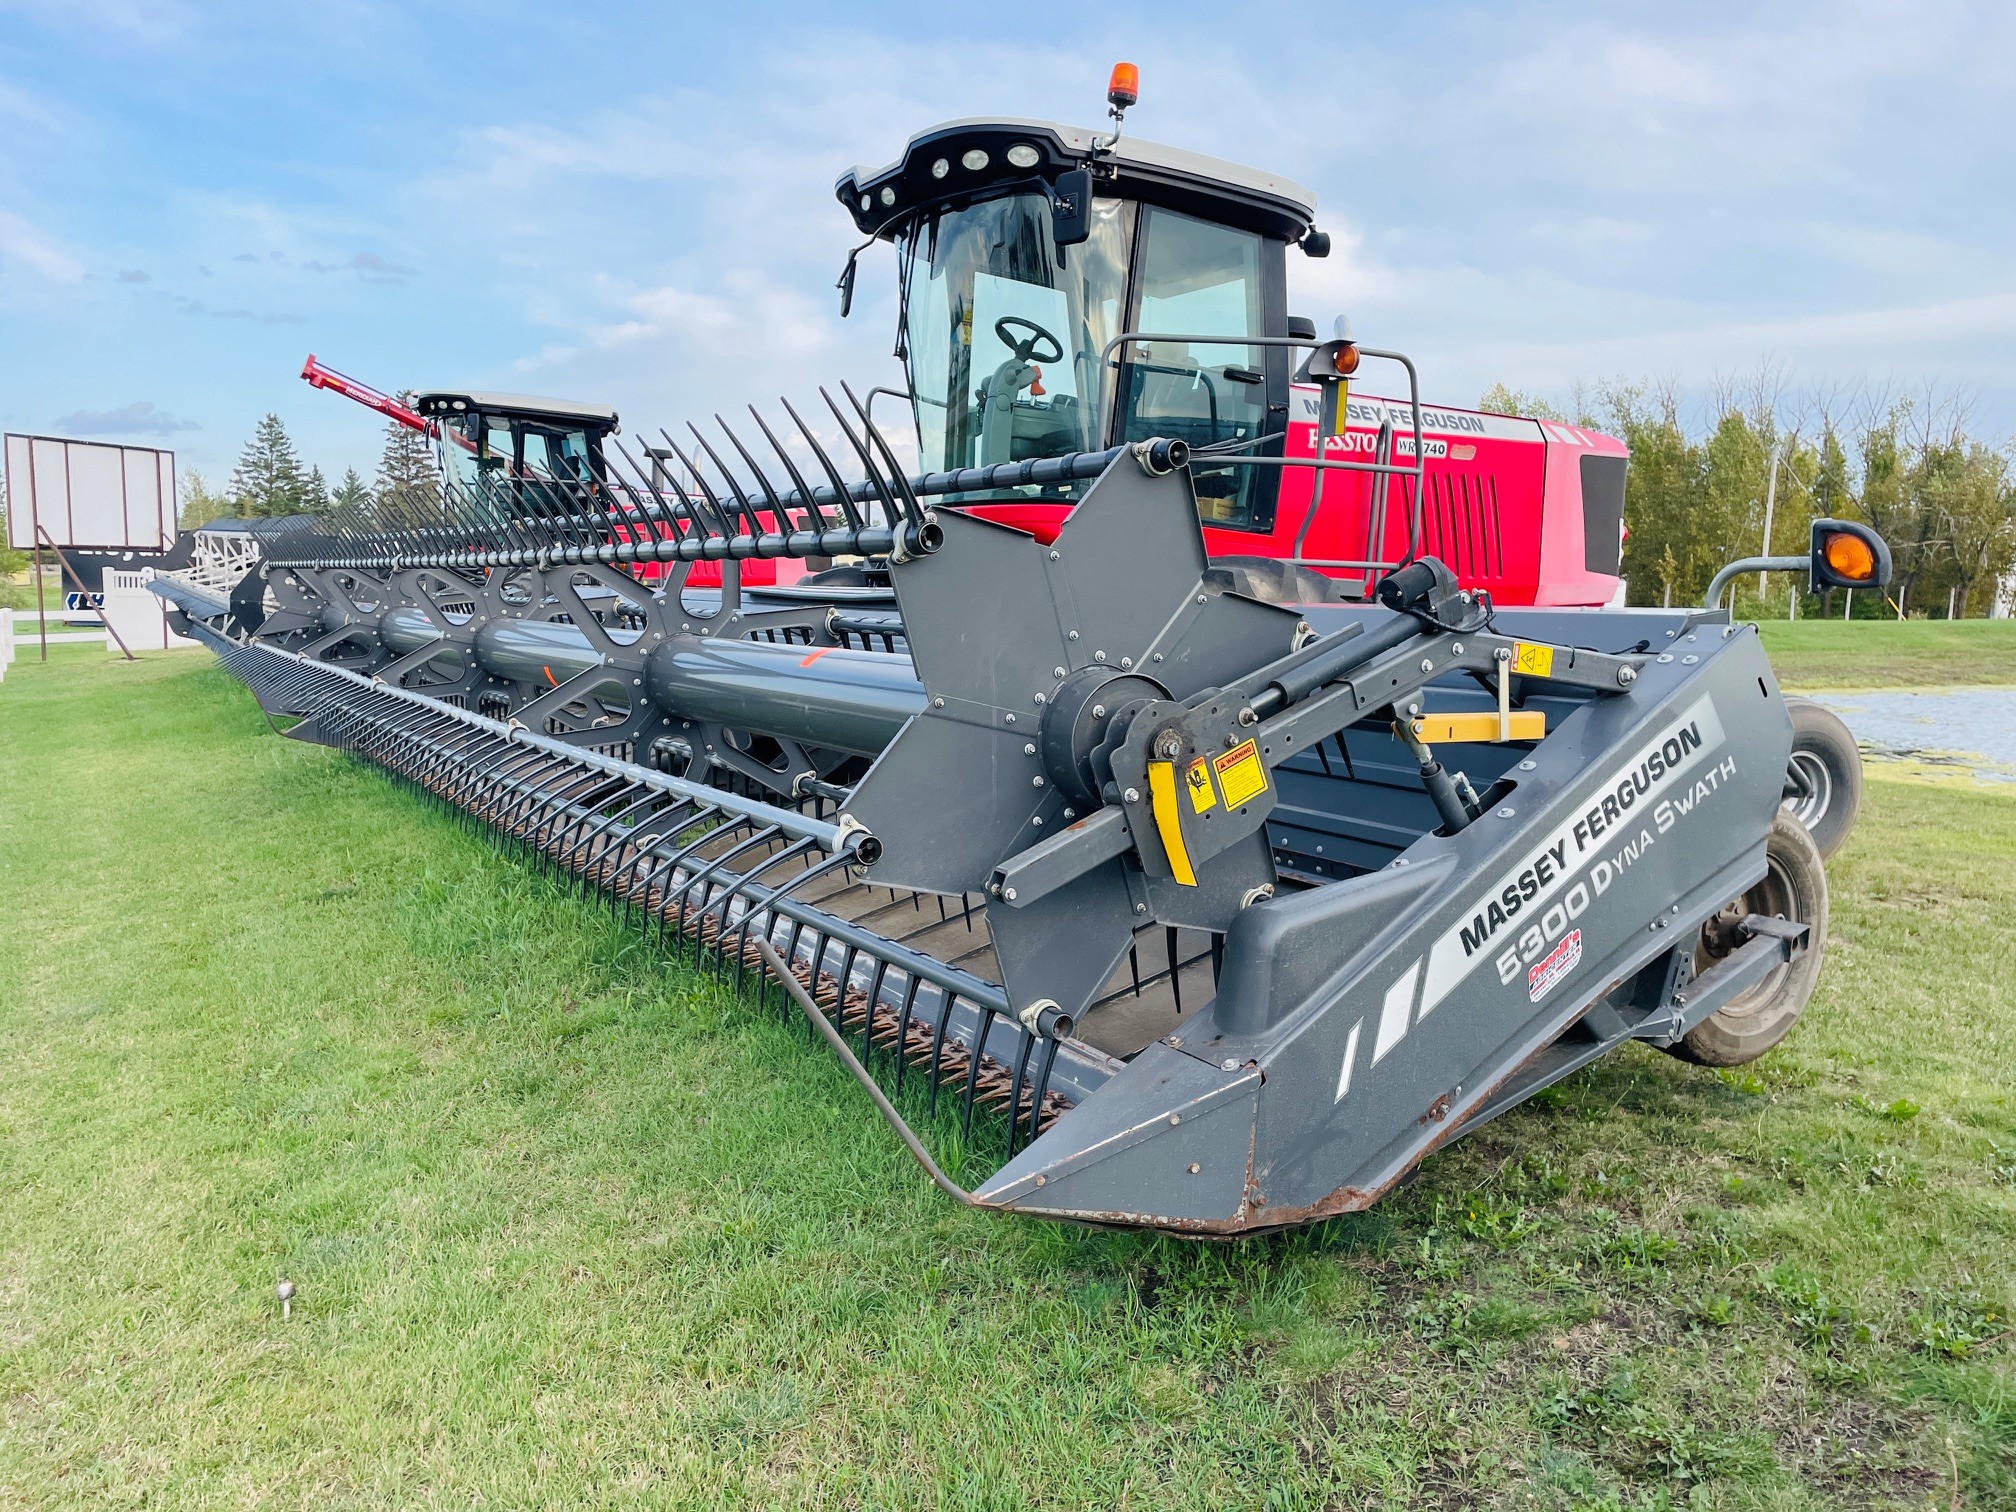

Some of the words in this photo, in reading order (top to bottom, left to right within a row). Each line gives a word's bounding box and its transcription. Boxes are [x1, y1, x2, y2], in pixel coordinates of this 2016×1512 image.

[346, 386, 379, 405] MERIDIAN
[1303, 399, 1382, 422] MSEY
[1388, 408, 1485, 433] FEGUSON
[1399, 440, 1445, 455] WR740
[1226, 746, 1252, 764] WARNING
[1459, 838, 1565, 957] MASSEY
[1573, 721, 1701, 851] FERGUSON
[1495, 881, 1590, 986] 5300
